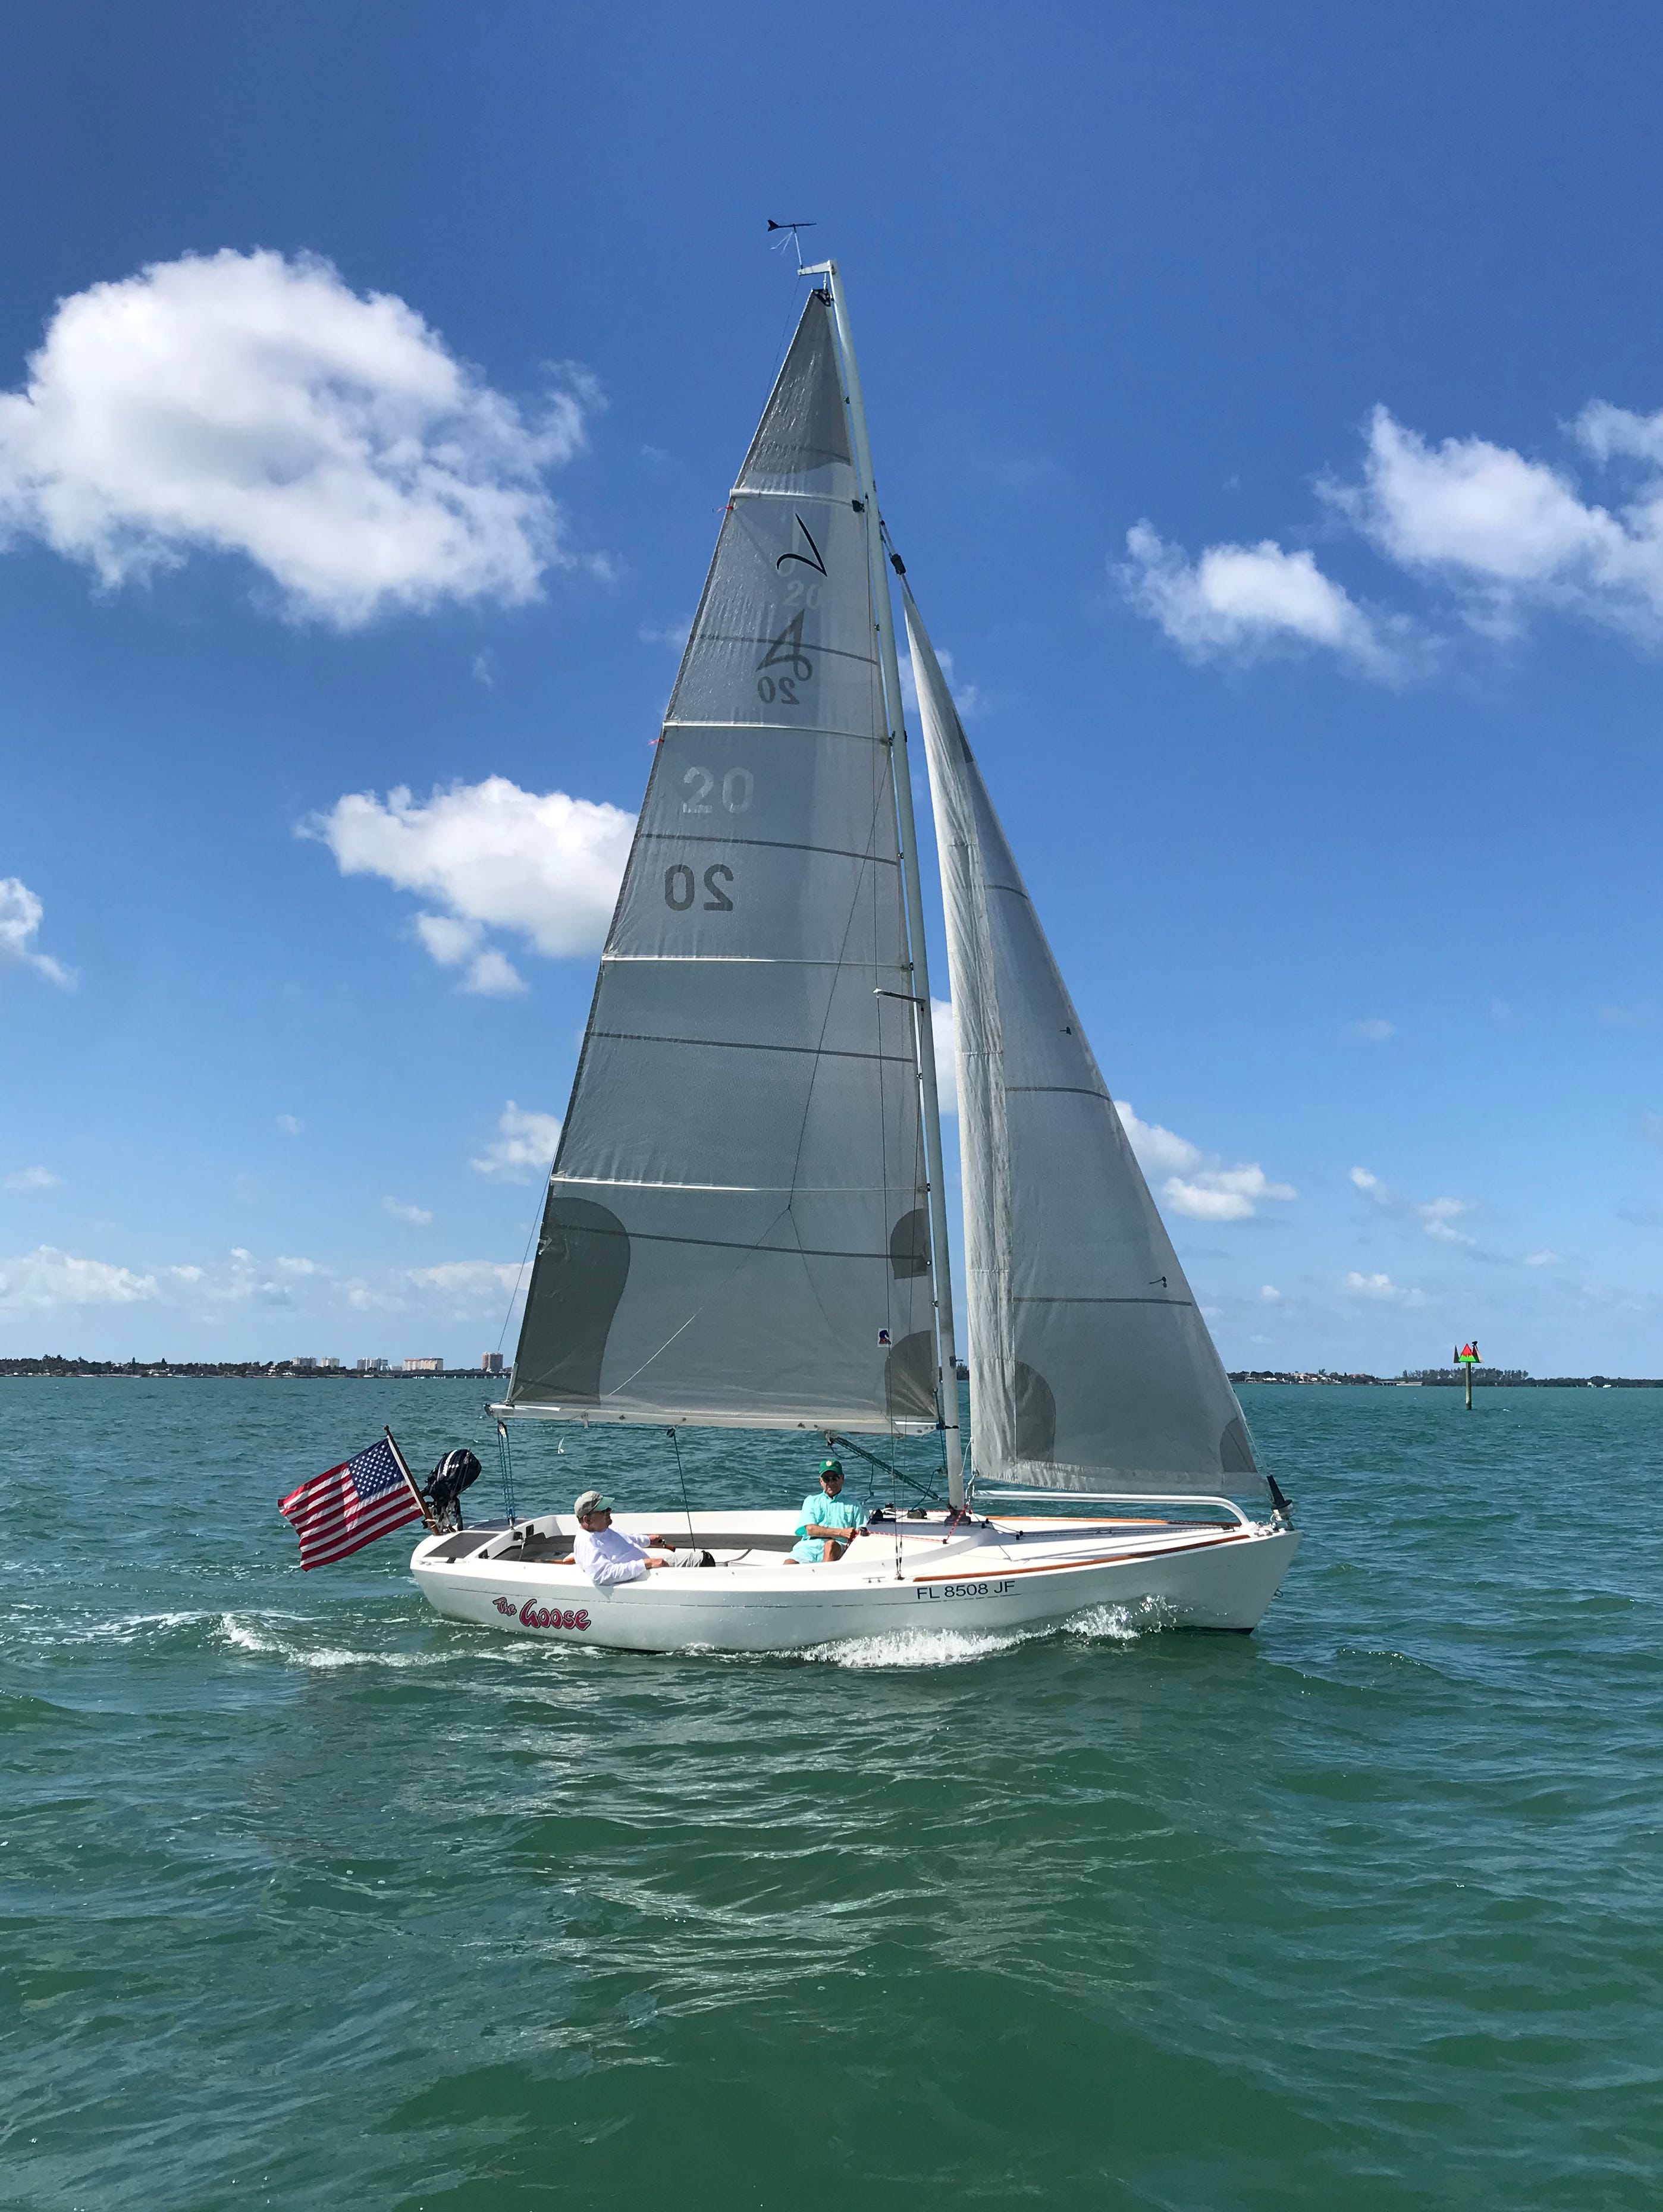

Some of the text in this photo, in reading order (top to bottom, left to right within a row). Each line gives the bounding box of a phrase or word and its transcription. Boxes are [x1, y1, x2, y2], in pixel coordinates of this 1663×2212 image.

[683, 766, 754, 814] 20
[917, 1581, 1016, 1600] FL 8508 JF
[492, 1597, 591, 1631] The Goose
